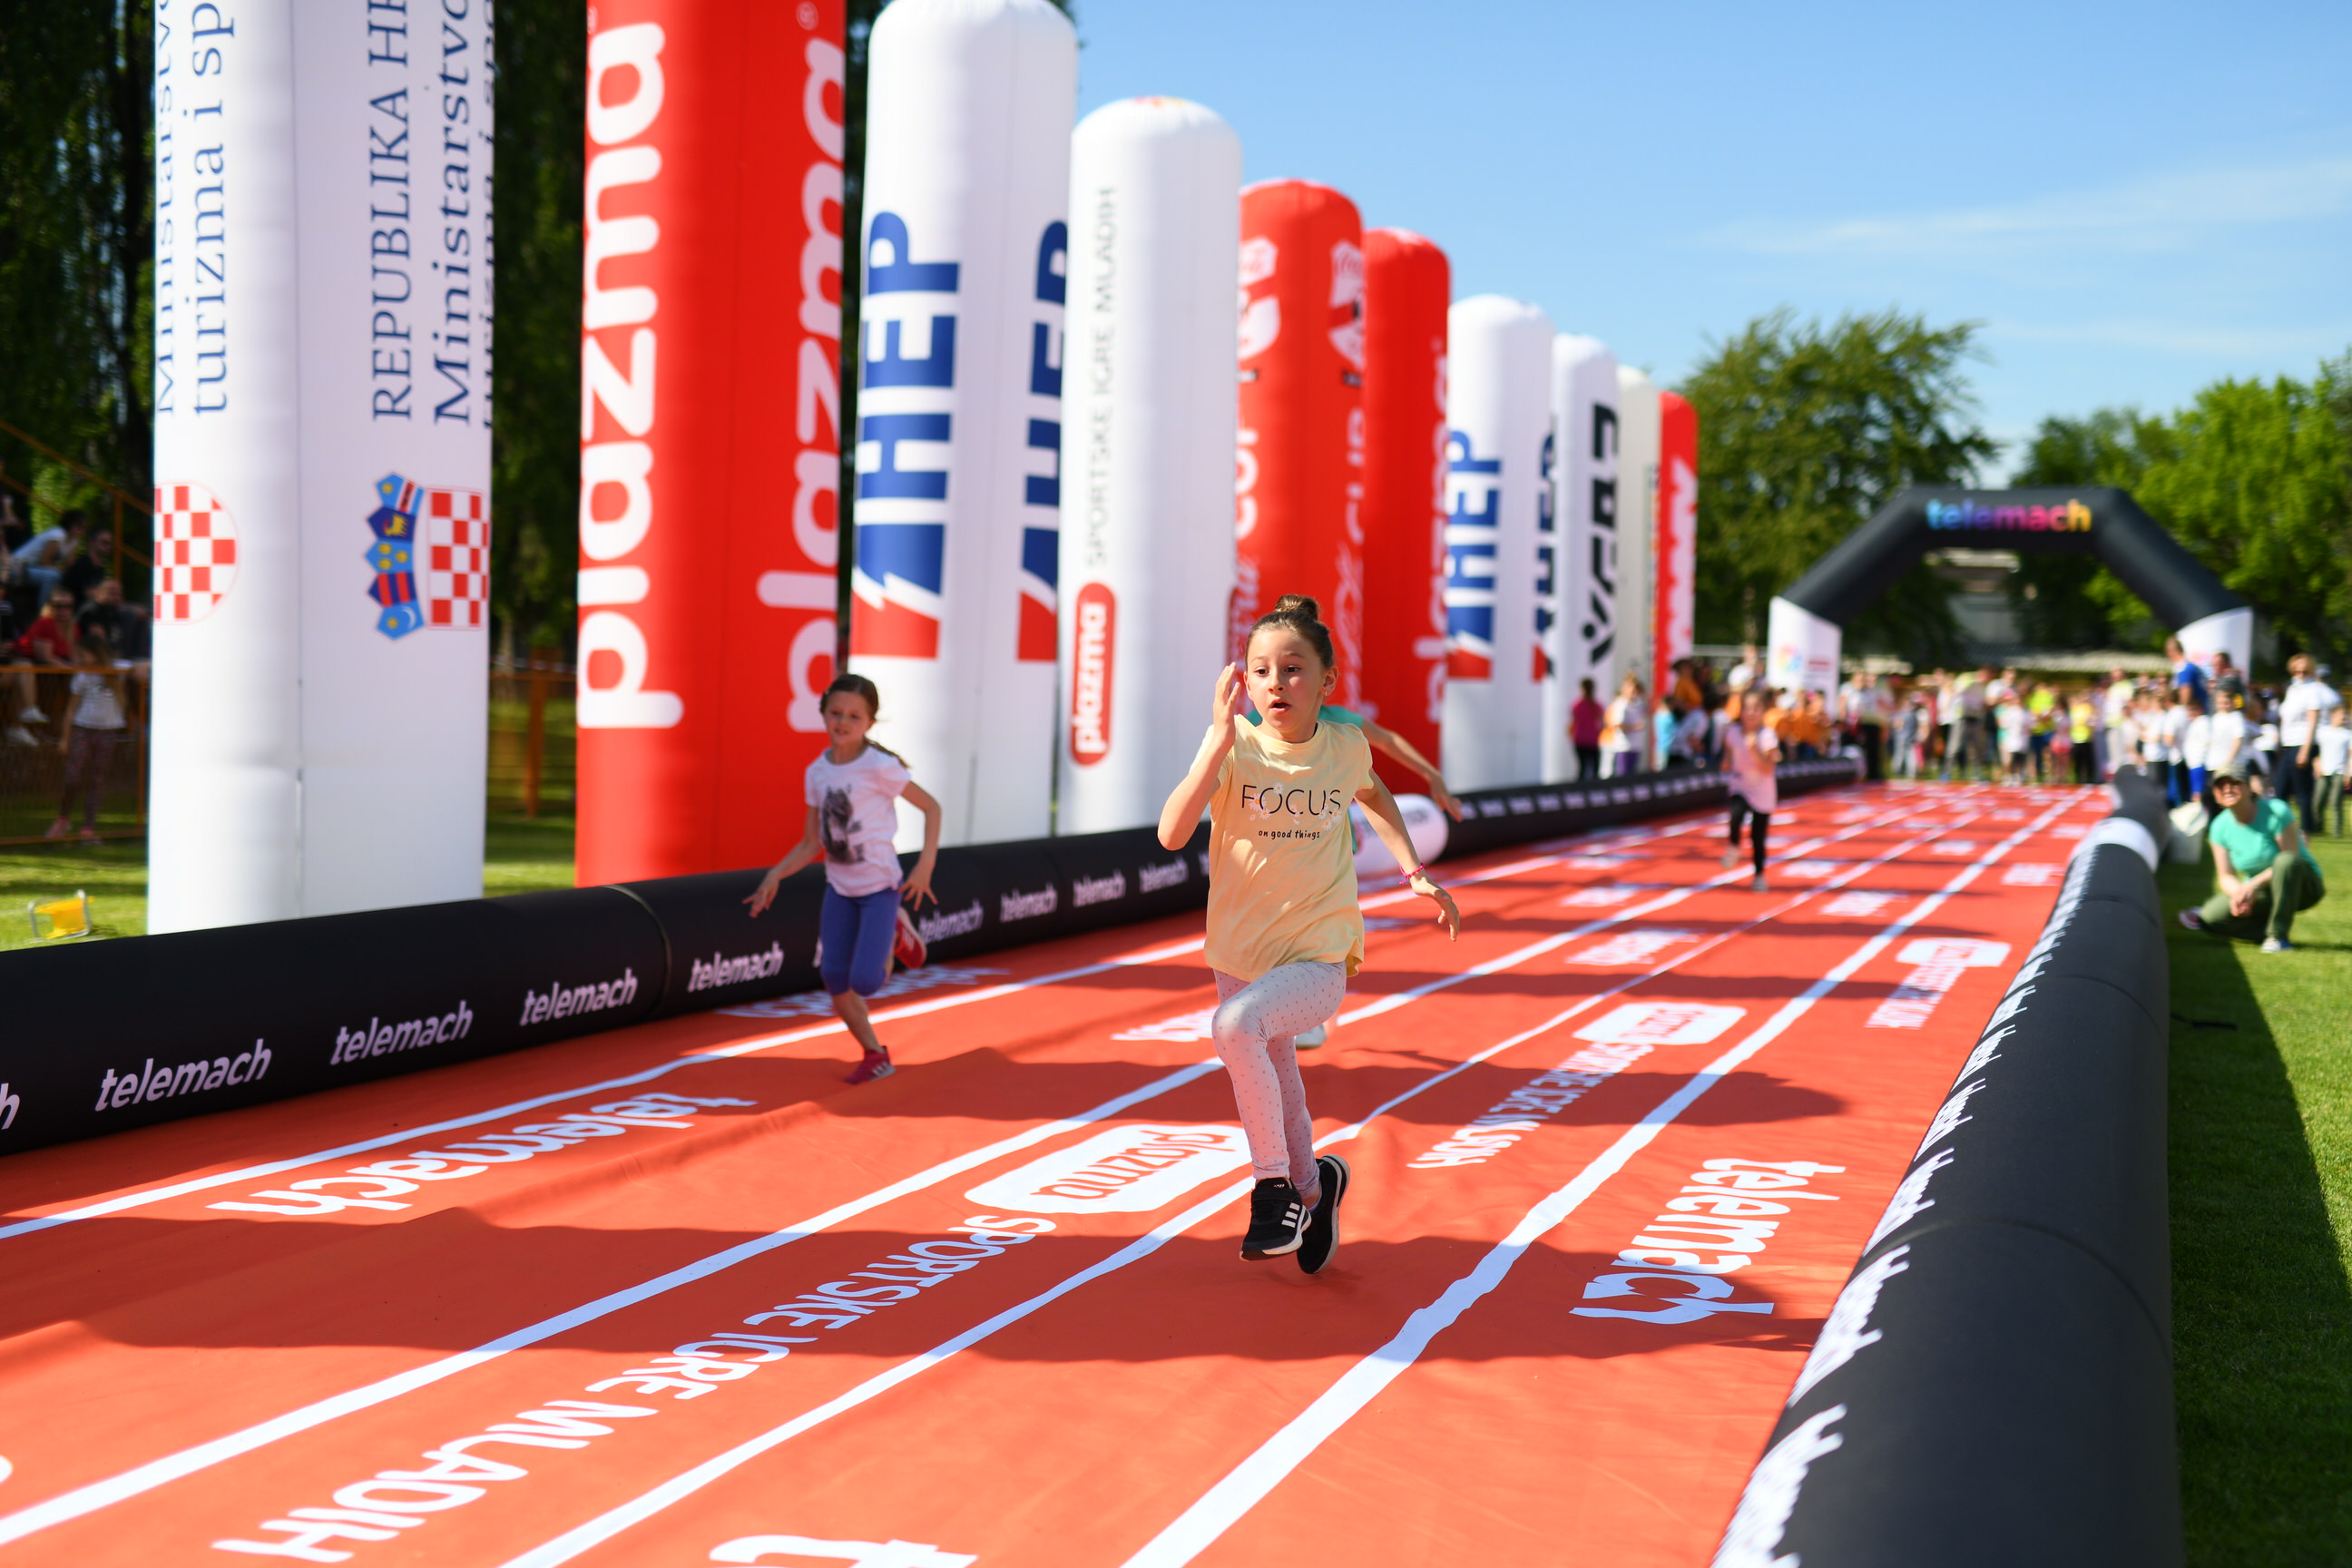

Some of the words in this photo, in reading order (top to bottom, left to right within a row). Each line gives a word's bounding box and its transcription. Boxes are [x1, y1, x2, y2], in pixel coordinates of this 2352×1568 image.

[182, 100, 223, 121] i
[155, 0, 174, 417] Ministarstv
[185, 143, 229, 416] turizma
[368, 88, 412, 421] REPUBLIKA
[577, 22, 683, 729] plazma
[859, 211, 960, 501] HEP
[1925, 498, 2092, 533] telemach
[1073, 603, 1108, 753] plazma
[1240, 784, 1342, 816] FOCUS
[1258, 829, 1269, 838] on
[1270, 829, 1292, 840] good
[1295, 829, 1321, 839] things
[519, 967, 637, 1026] telemach
[687, 941, 784, 994] telemach
[330, 1000, 474, 1065] telemach
[94, 1038, 272, 1112] telemach
[204, 1092, 759, 1217] telemach
[1029, 1130, 1237, 1200] plazma
[743, 1215, 1057, 1329] SPORTSKE
[583, 1332, 819, 1400] IGRE
[212, 1400, 661, 1563] MLADIH
